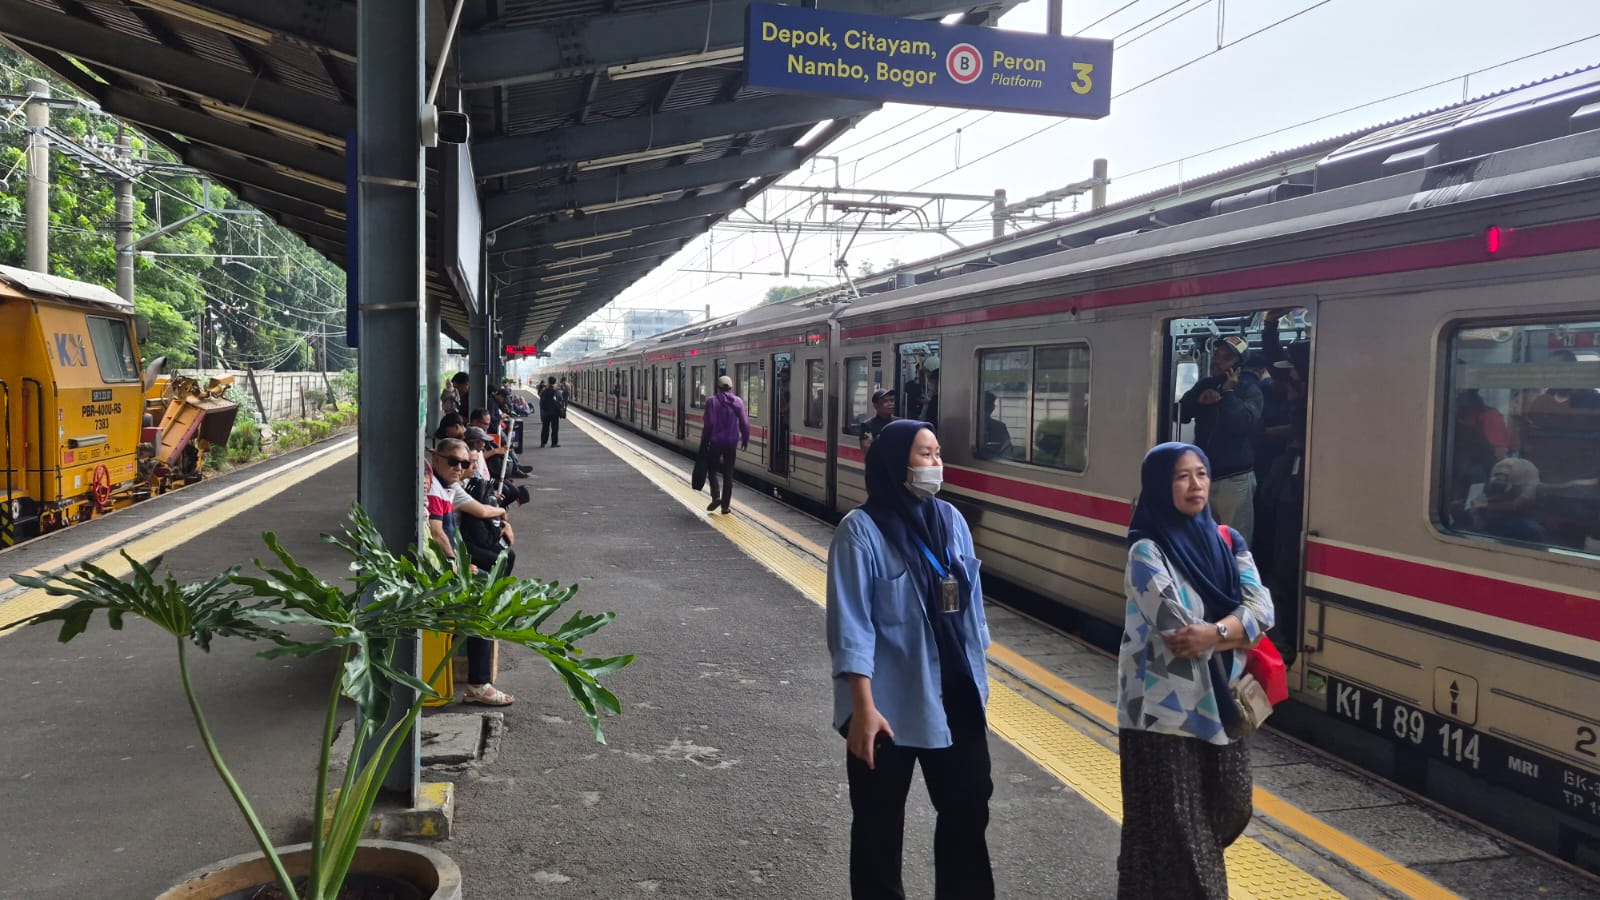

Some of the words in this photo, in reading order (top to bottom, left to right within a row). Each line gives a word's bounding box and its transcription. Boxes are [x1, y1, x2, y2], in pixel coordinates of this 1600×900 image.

[762, 22, 837, 50] Depok,
[844, 30, 937, 59] Citayam,
[787, 54, 869, 83] Nambo,
[876, 61, 937, 87] Bogor
[960, 57, 970, 70] B
[992, 51, 1046, 72] Peron
[991, 73, 1042, 89] Platform
[1070, 62, 1093, 95] 3
[1372, 698, 1383, 730] 1
[1392, 706, 1425, 744] 89
[1439, 723, 1480, 769] 114
[1575, 726, 1597, 757] 2
[1508, 755, 1539, 778] MRI
[1563, 789, 1584, 807] TP
